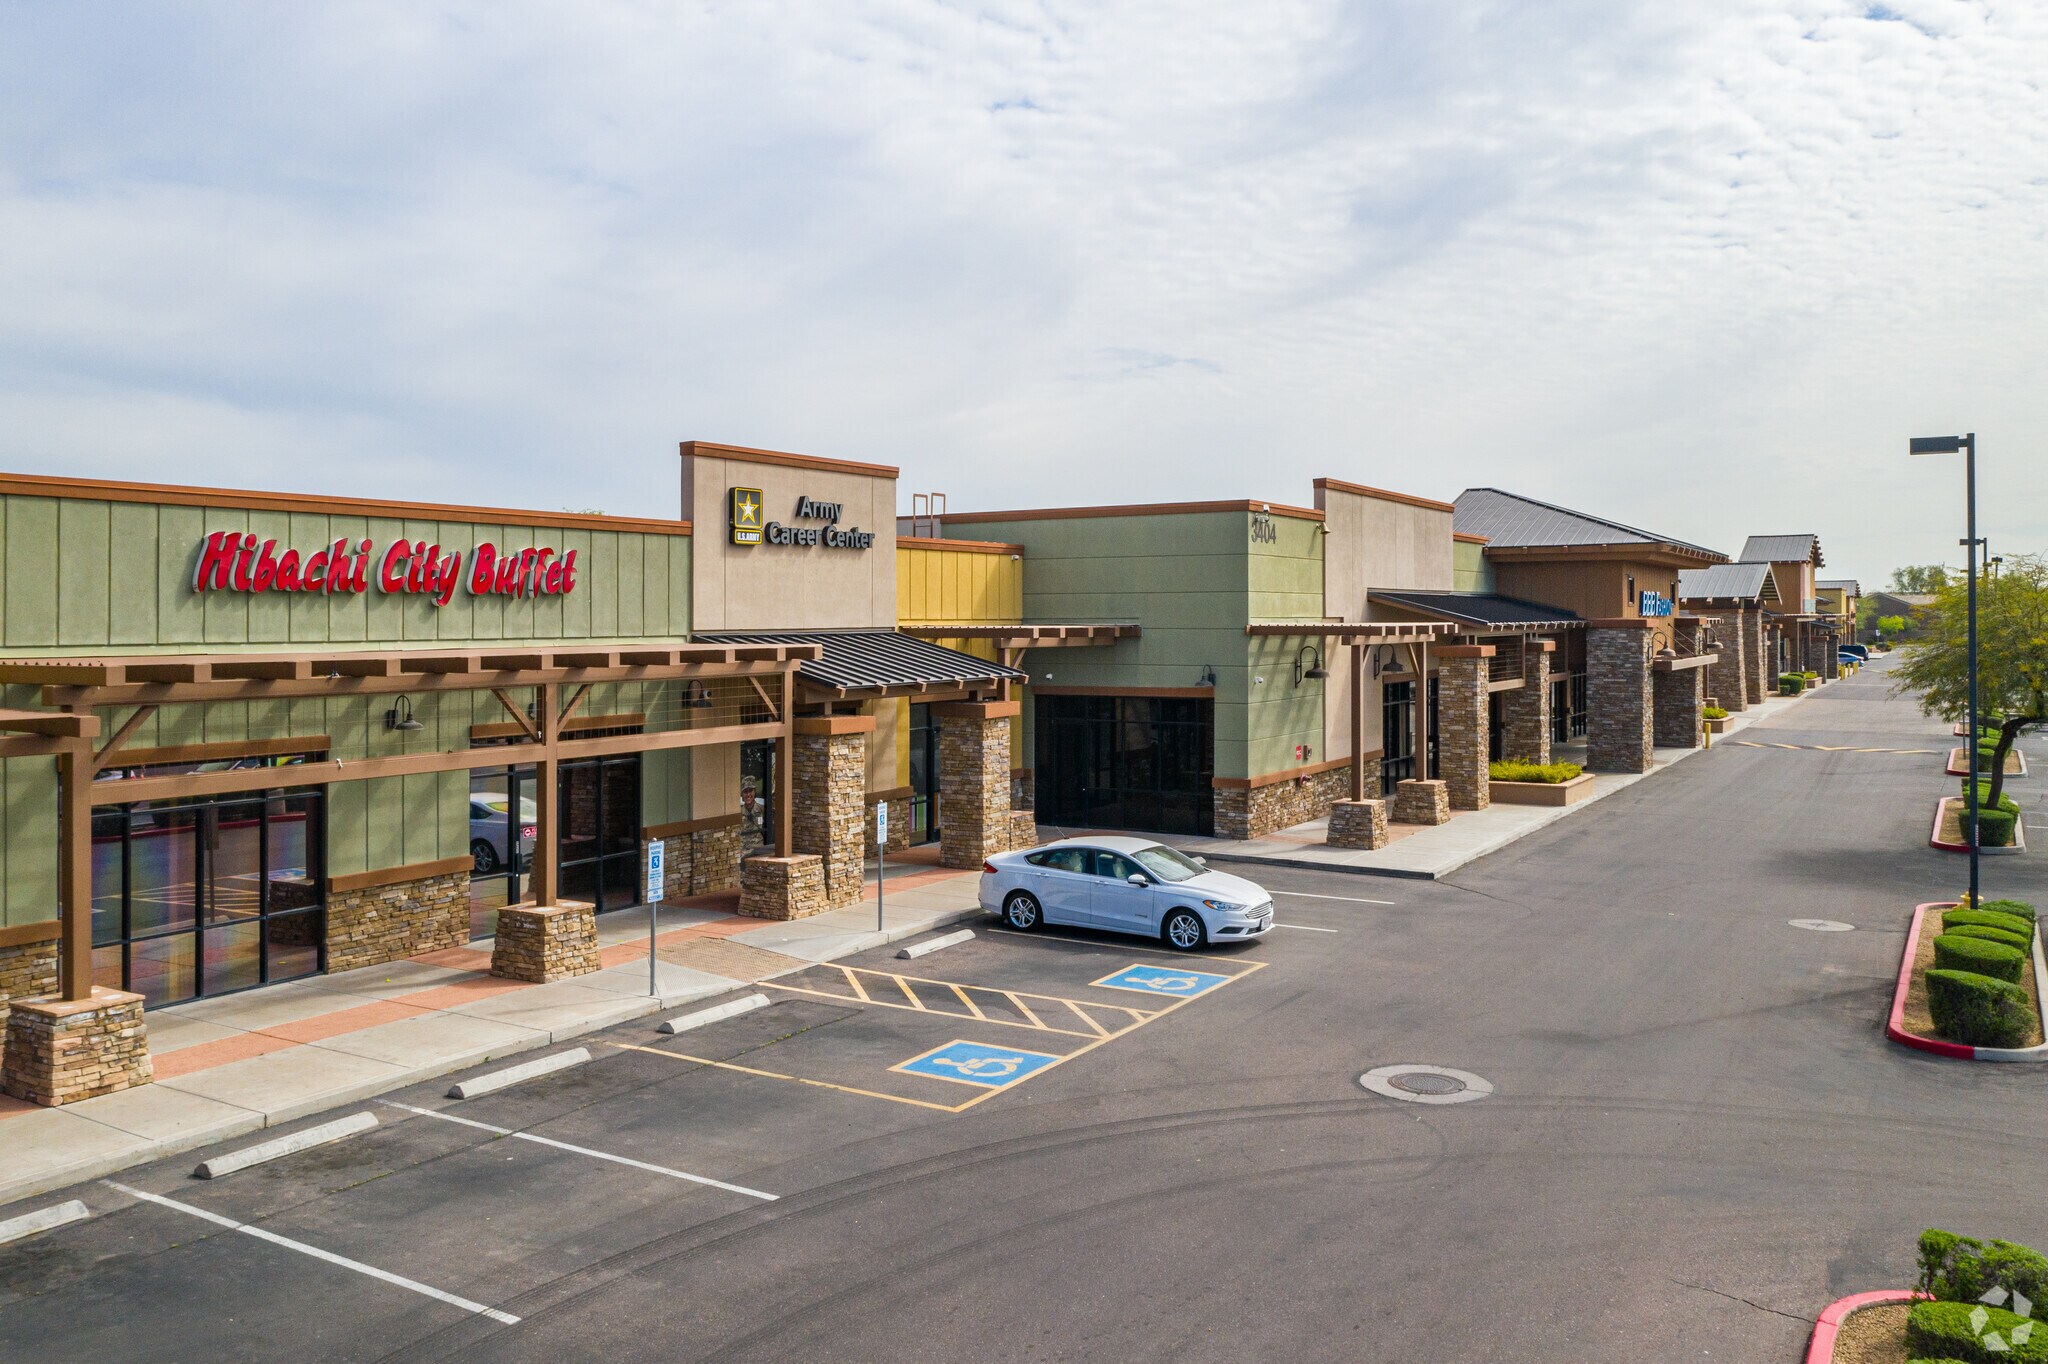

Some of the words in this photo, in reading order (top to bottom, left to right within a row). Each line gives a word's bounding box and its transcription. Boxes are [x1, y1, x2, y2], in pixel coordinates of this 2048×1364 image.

[797, 496, 844, 524] Army
[765, 521, 822, 546] Career
[822, 525, 875, 549] Center
[1251, 520, 1277, 544] 3404
[193, 531, 373, 596] Hibachi
[377, 538, 462, 607] City
[467, 542, 578, 599] Buffet
